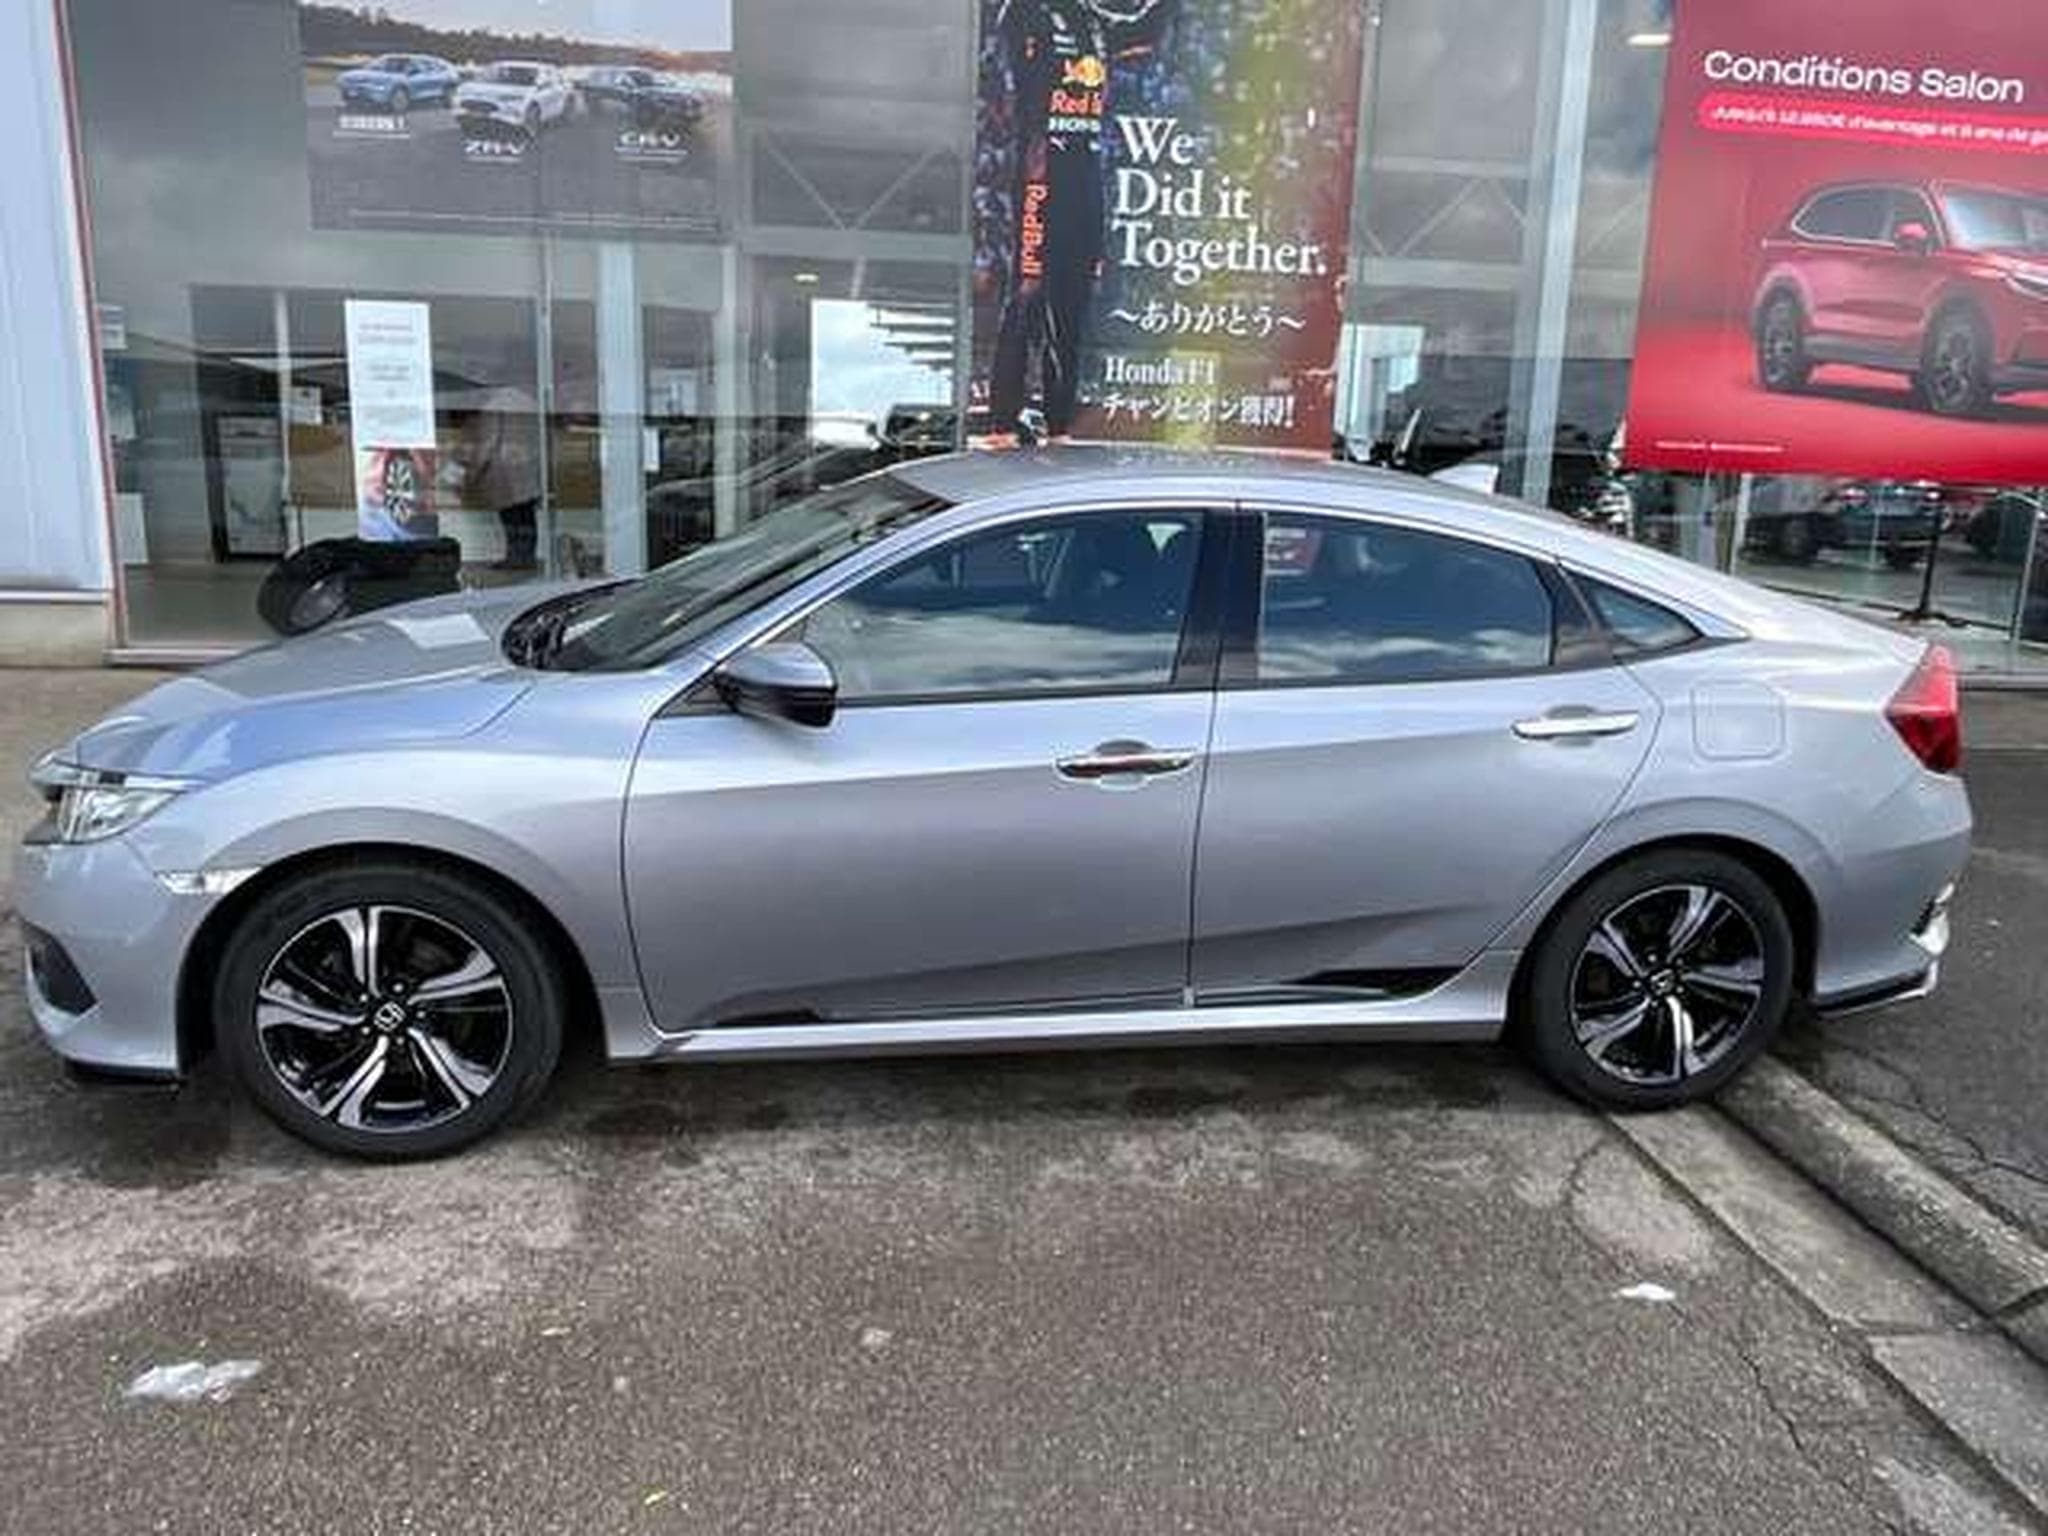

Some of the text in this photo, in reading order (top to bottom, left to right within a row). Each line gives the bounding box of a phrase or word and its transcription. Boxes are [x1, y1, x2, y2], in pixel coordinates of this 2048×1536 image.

[1703, 50, 2025, 103] Conditions Salon
[1116, 115, 1194, 164] We
[1113, 168, 1252, 219] Did it
[1111, 218, 1328, 287] Together.
[1104, 355, 1184, 385] Honda
